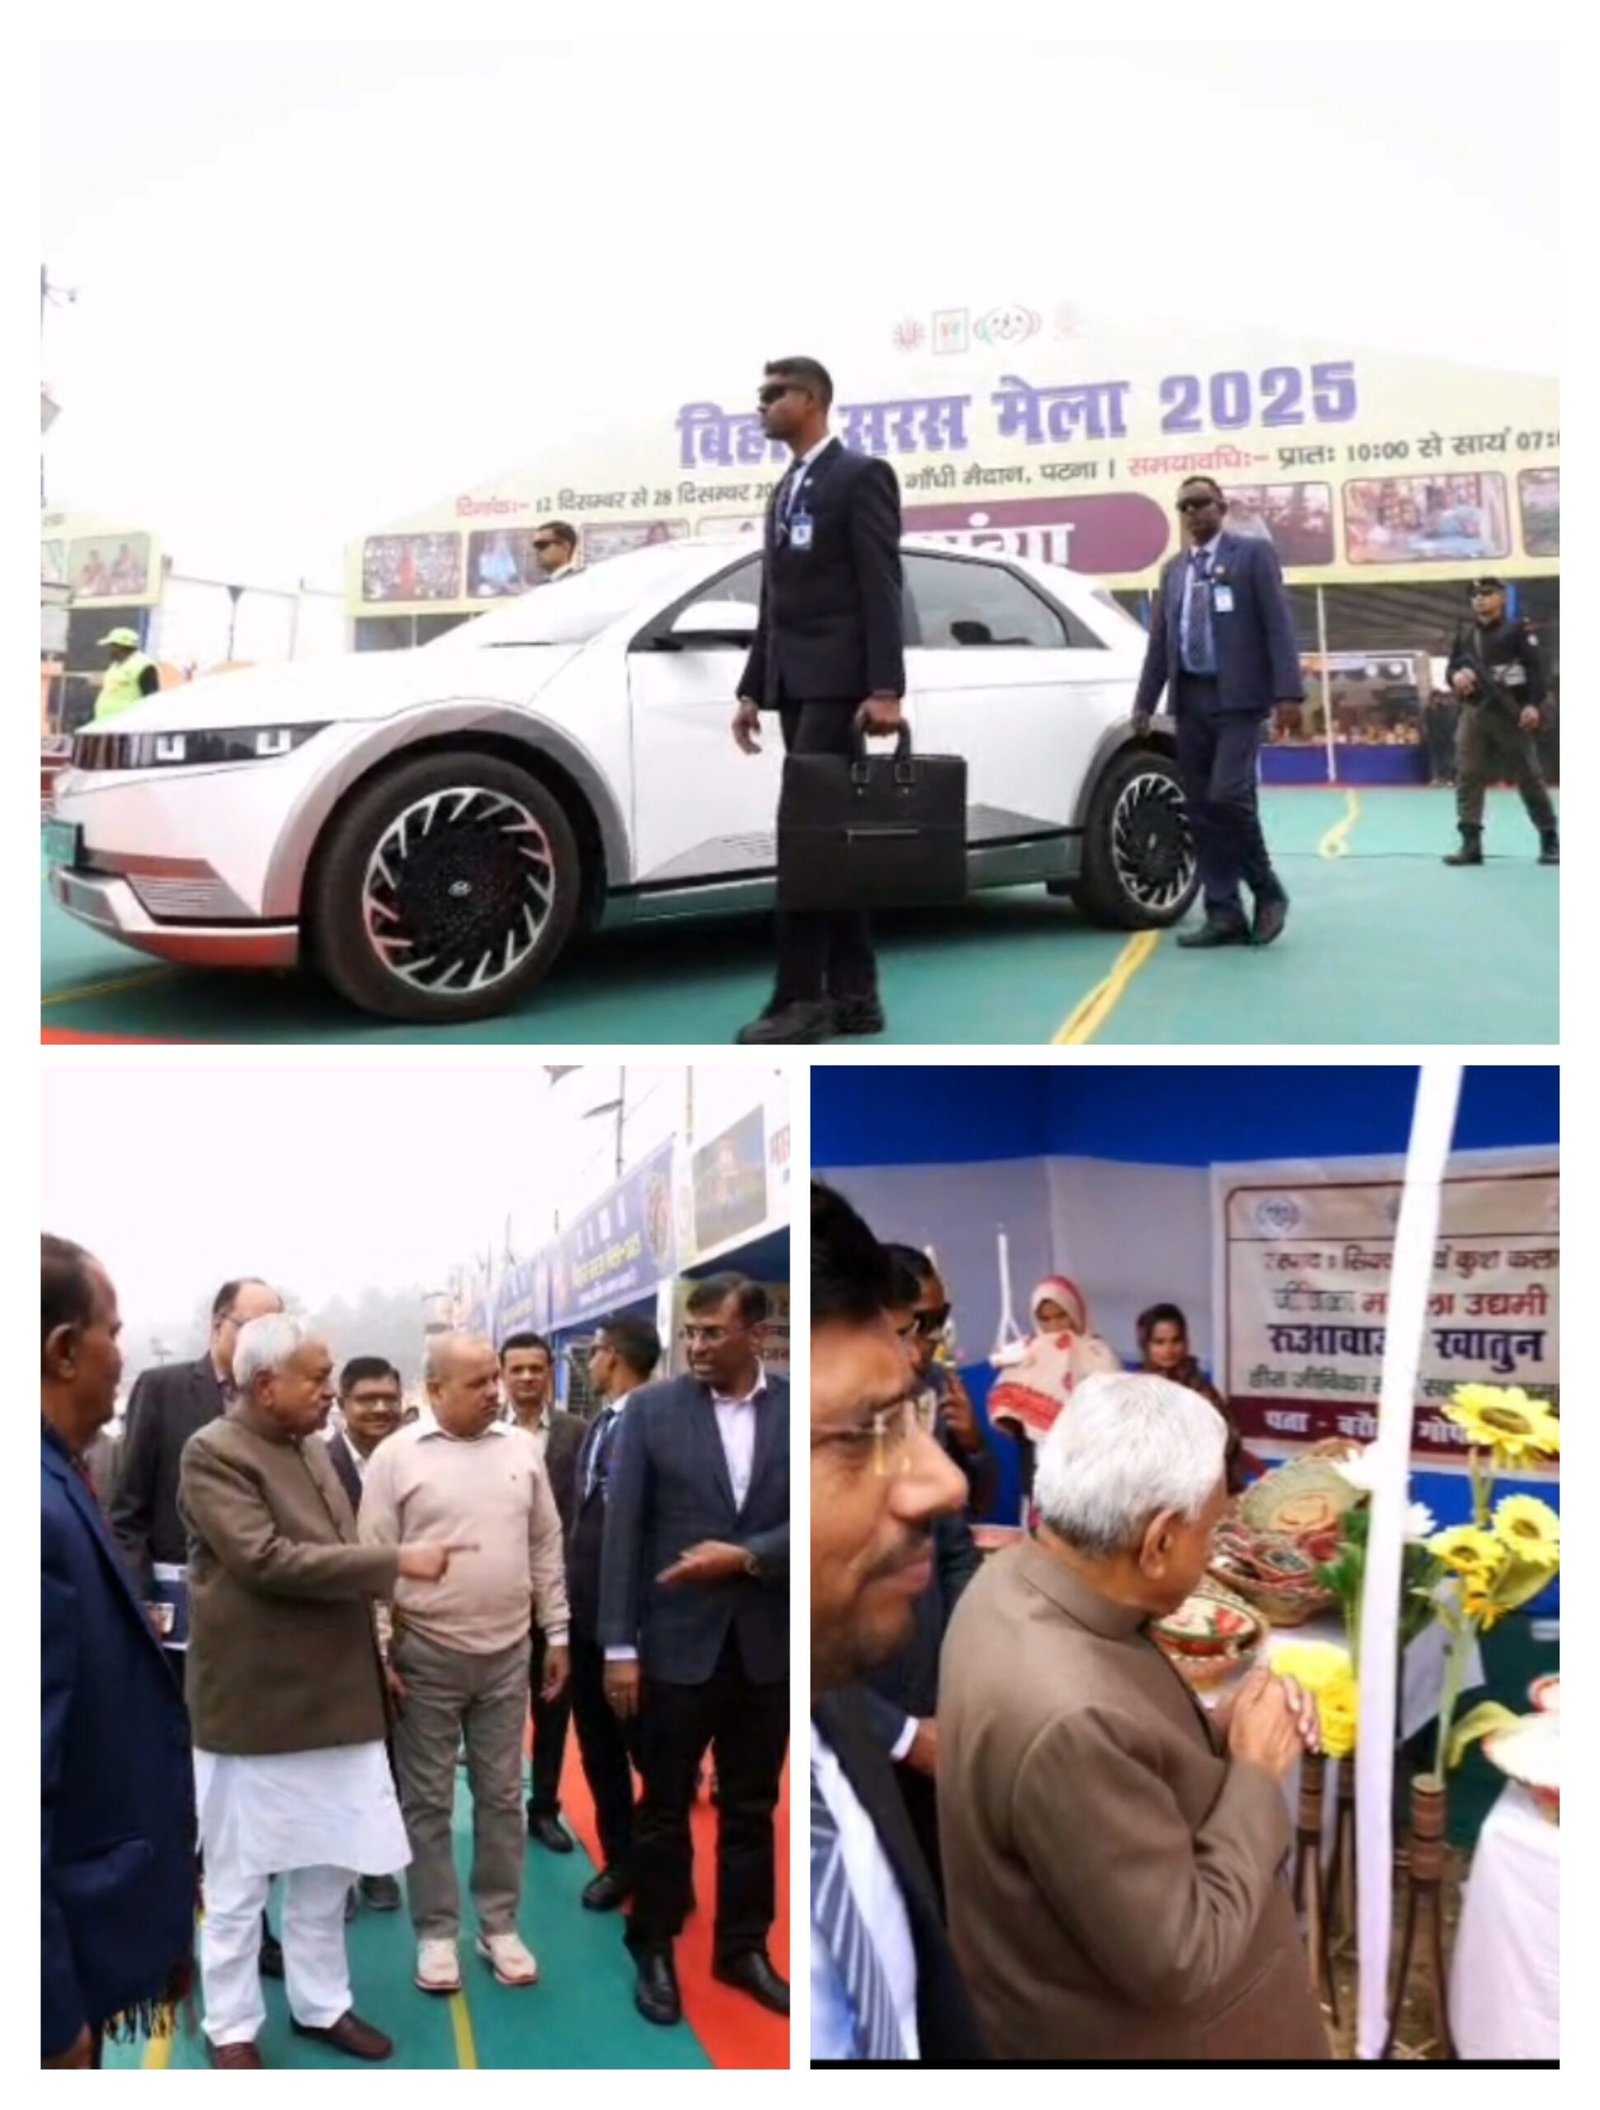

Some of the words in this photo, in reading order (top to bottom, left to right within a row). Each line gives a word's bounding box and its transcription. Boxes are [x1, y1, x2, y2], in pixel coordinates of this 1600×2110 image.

[838, 396, 972, 455] सरस
[991, 373, 1131, 445] मेला
[1159, 361, 1358, 434] 2025
[631, 486, 648, 508] से
[1040, 461, 1099, 482] पटना
[1418, 431, 1442, 458] से
[1451, 426, 1512, 456] सायं
[1463, 1283, 1550, 1317] उद्यमी
[1431, 1328, 1547, 1376] खातुन
